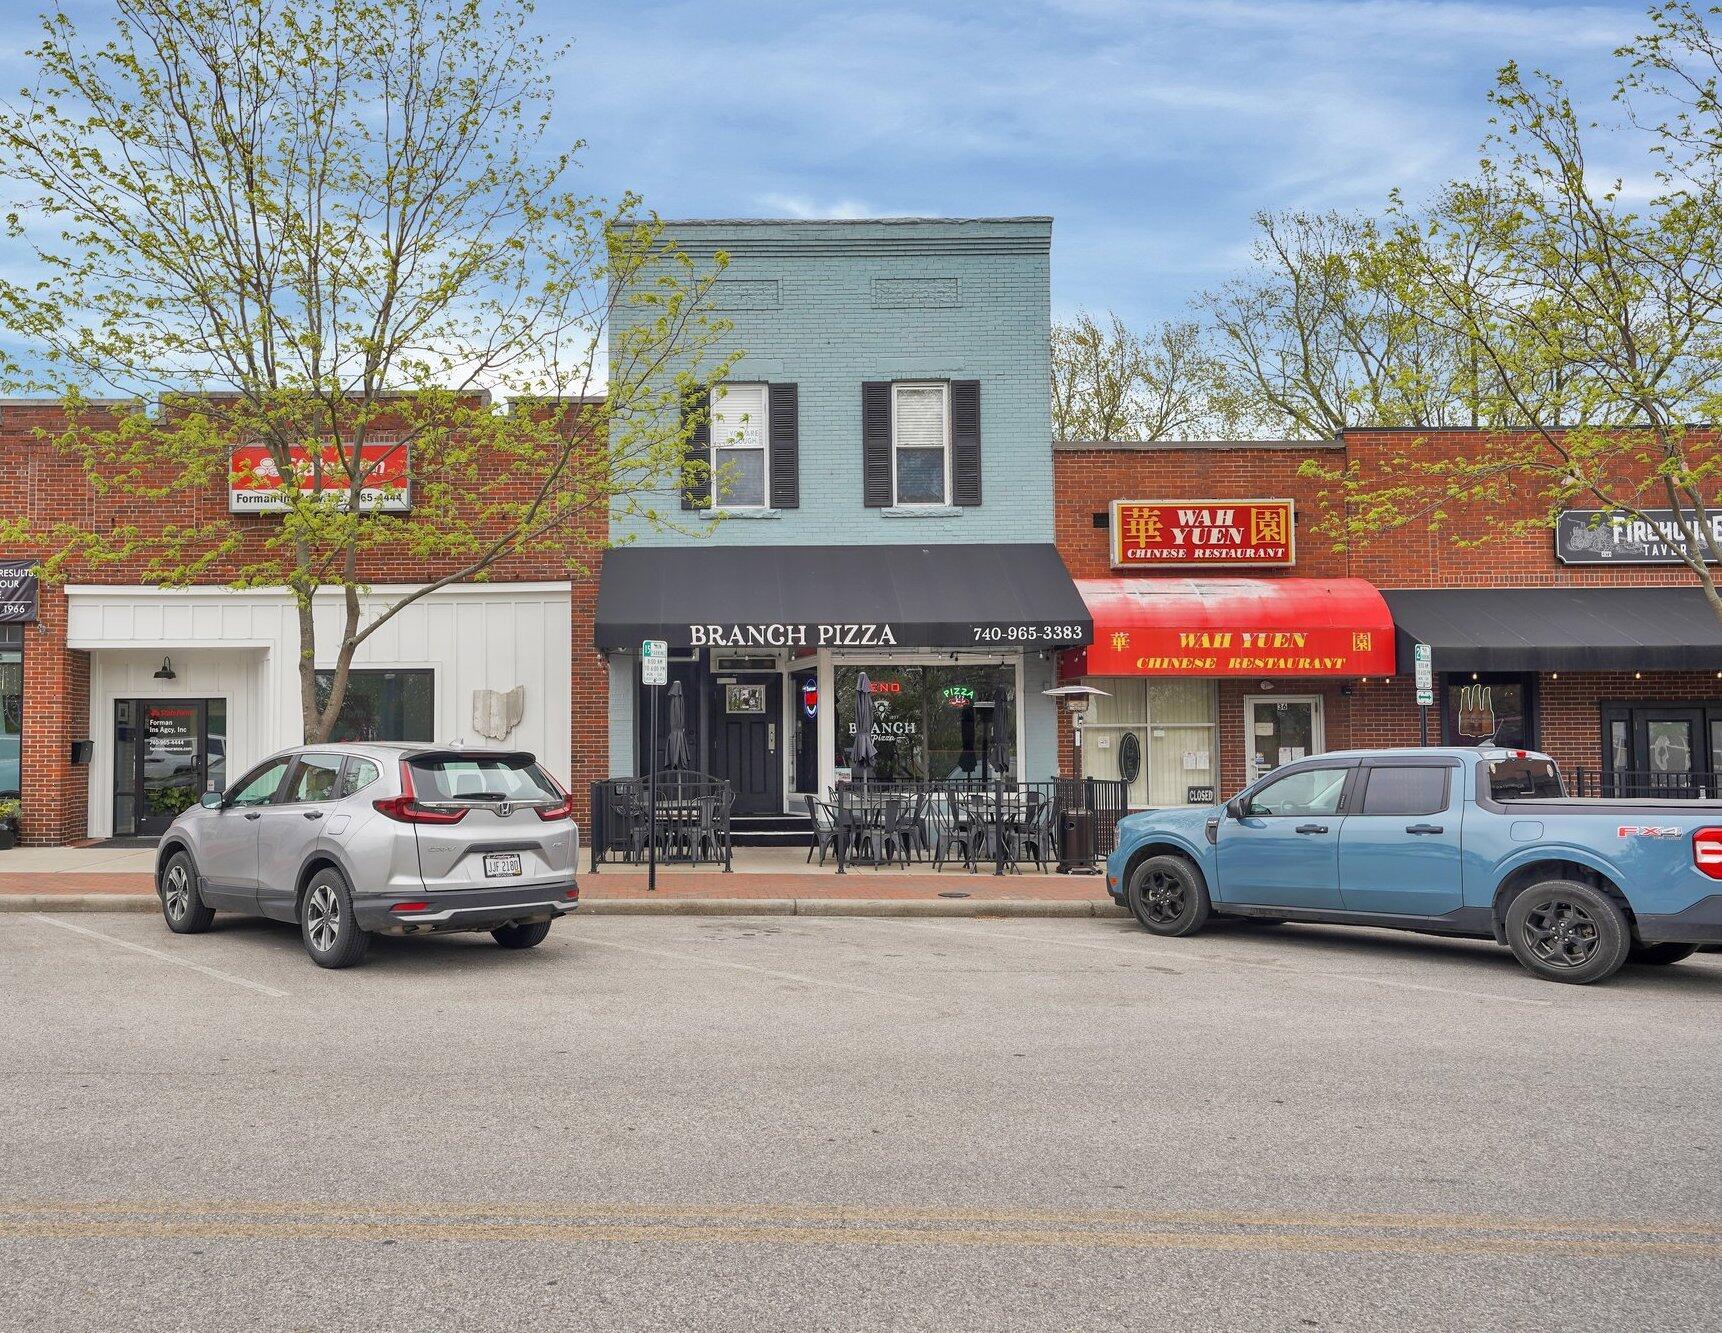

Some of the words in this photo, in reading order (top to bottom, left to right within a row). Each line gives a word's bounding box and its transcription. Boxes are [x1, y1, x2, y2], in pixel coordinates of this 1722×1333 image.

[236, 493, 276, 503] Forman
[1176, 509, 1236, 526] WAH
[1123, 508, 1163, 548] 華
[1251, 507, 1286, 546] 園
[1170, 527, 1245, 545] YUEN
[1127, 549, 1187, 559] CHINESE
[1194, 548, 1285, 558] RESTAURANT
[4, 604, 25, 613] 1966
[690, 624, 806, 646] BRANCH
[818, 624, 897, 645] PIZZA
[973, 625, 1083, 641] 740-965-3383
[1179, 632, 1233, 648] WAH
[1240, 632, 1309, 648] YUEN
[1110, 632, 1130, 651] 華
[1353, 631, 1371, 651] 園
[1136, 657, 1217, 669] CHINESE
[1228, 657, 1346, 669] RESTAURANT
[943, 687, 975, 699] PIZZA
[848, 722, 916, 734] BANCH
[1189, 789, 1214, 802] CLOSED
[1618, 826, 1683, 838] FX4
[488, 861, 499, 873] JJF
